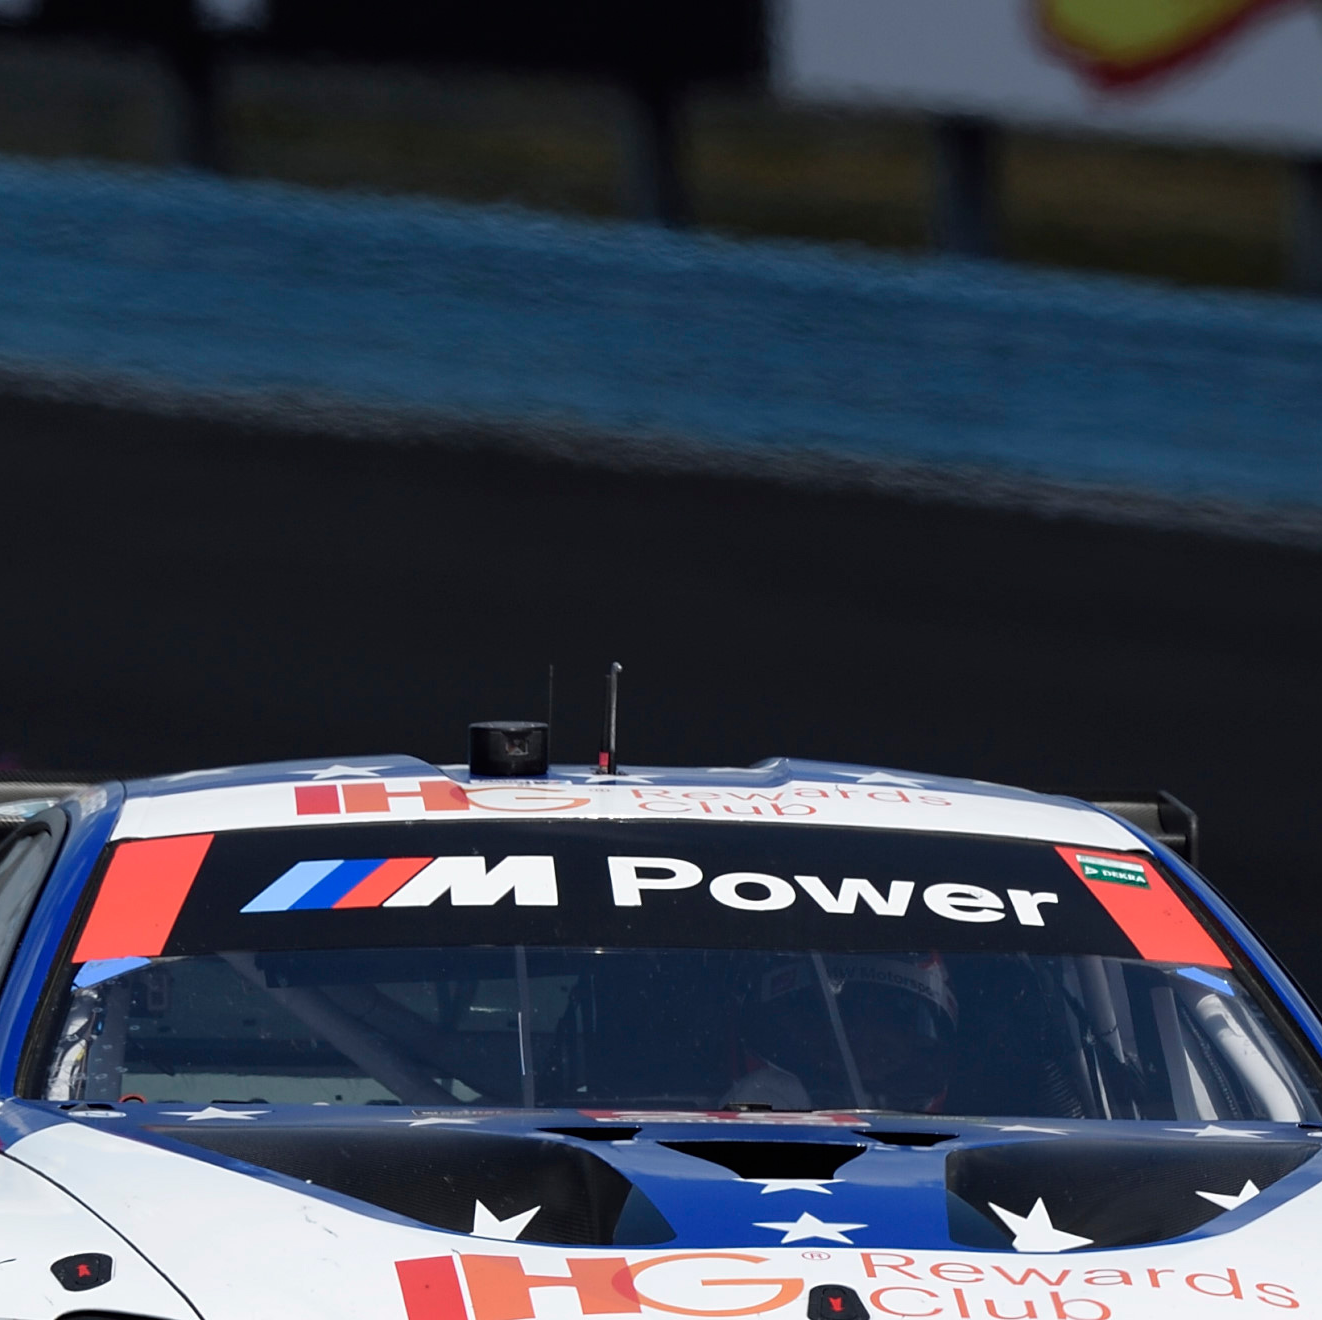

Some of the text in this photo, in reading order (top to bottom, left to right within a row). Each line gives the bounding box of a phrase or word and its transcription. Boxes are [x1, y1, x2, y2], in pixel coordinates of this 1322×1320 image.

[294, 780, 953, 816] IHG Rewards
[638, 801, 818, 817] Club
[607, 855, 1058, 928] Power
[1101, 868, 1147, 884] DEKRA
[864, 1252, 1302, 1310] Rewards
